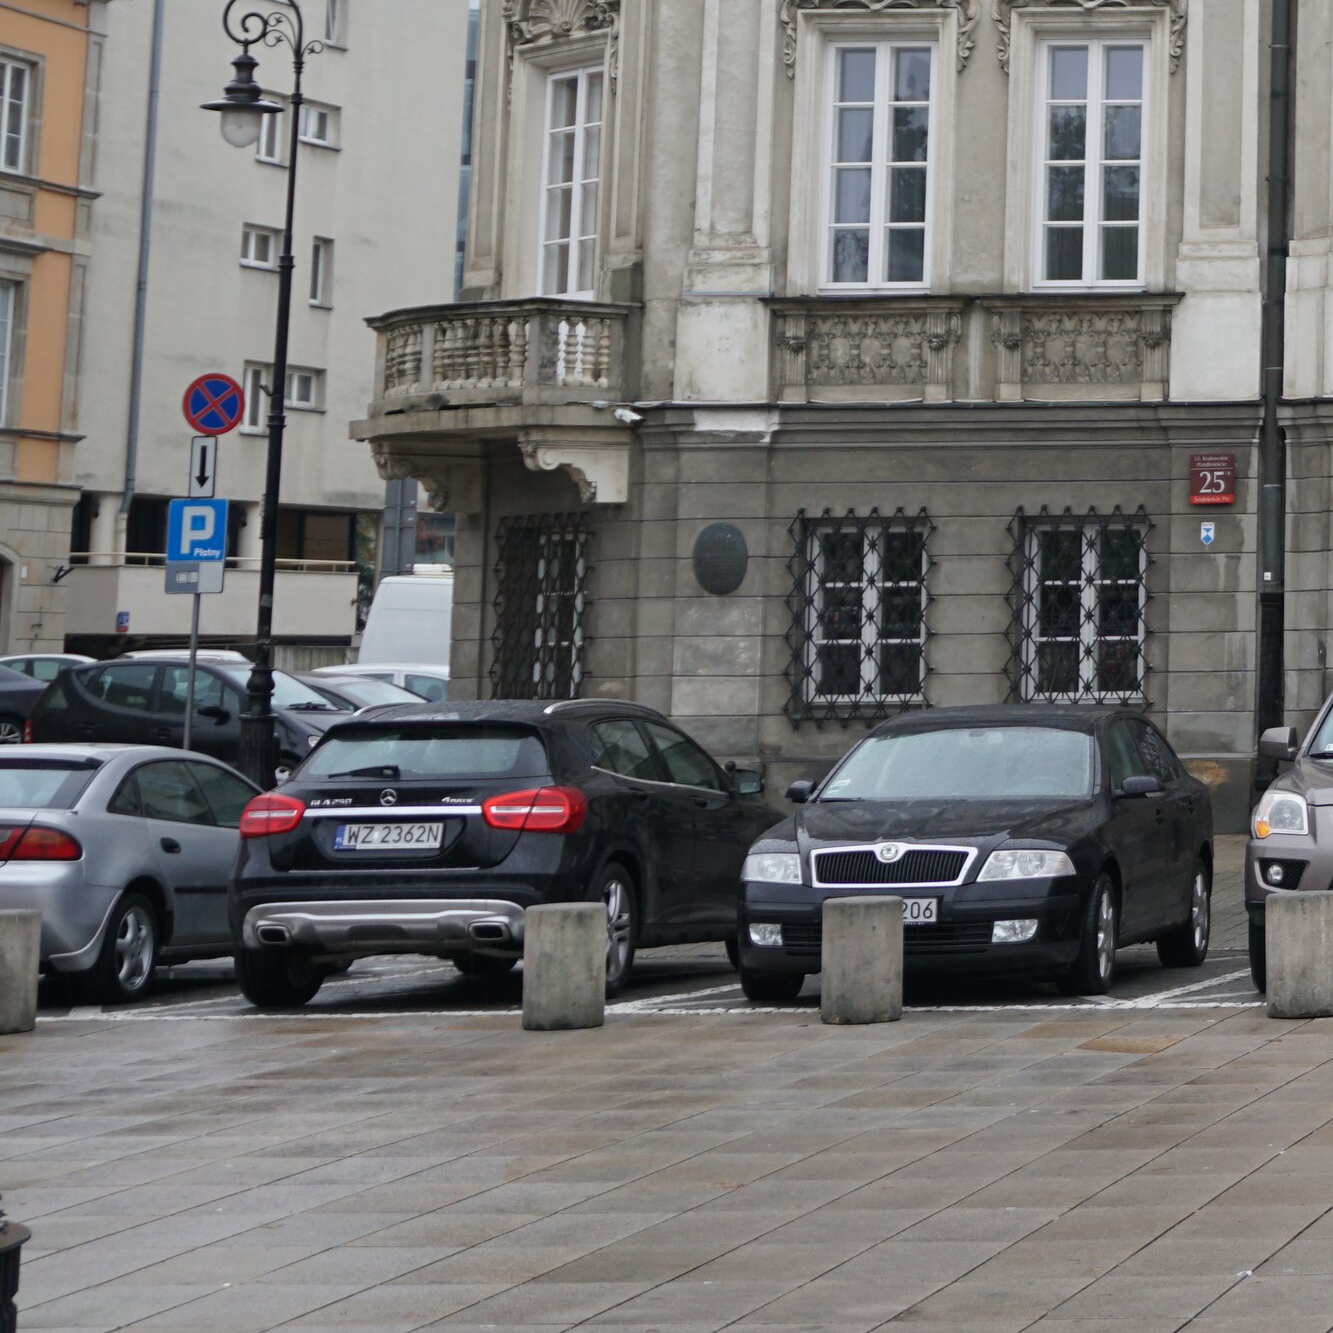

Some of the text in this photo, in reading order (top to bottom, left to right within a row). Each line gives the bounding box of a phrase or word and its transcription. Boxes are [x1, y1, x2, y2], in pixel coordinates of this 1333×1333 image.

[1199, 471, 1226, 493] 25
[181, 506, 215, 554] P
[348, 825, 440, 844] WZ 2362N
